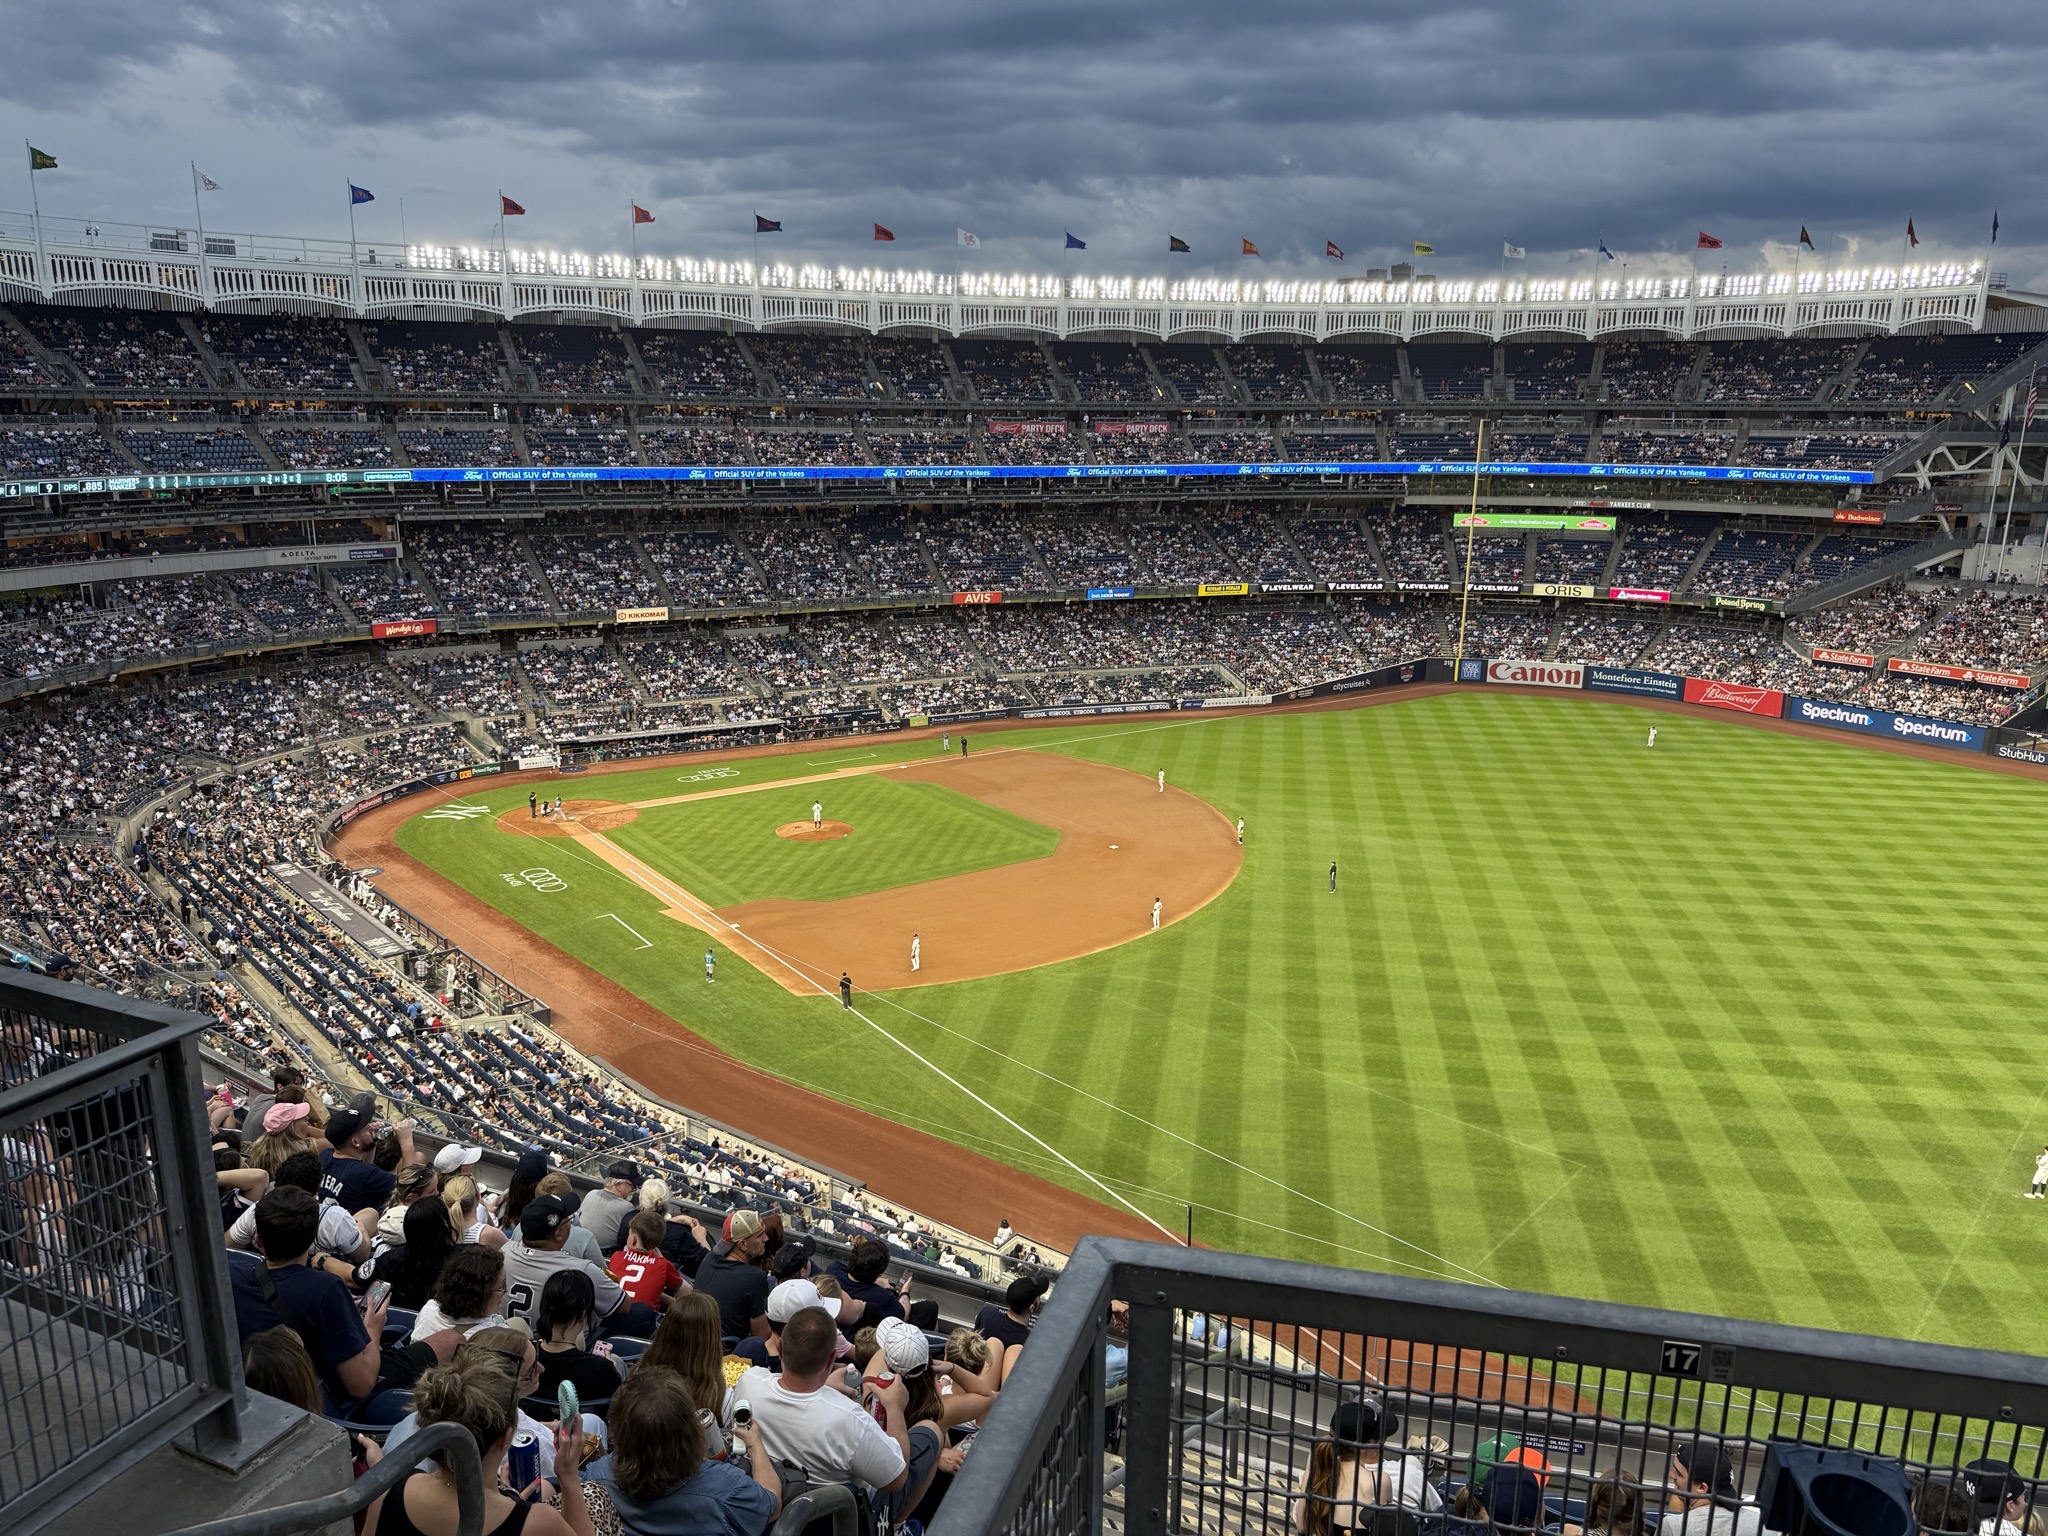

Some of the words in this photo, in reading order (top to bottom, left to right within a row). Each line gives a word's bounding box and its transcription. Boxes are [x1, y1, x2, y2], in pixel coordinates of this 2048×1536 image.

[1022, 424, 1044, 433] PARTY
[1046, 424, 1064, 433] DECK
[1126, 424, 1148, 433] PARTY
[1150, 425, 1168, 433] DECK
[326, 473, 348, 483] 8:05
[46, 484, 52, 493] 9
[83, 482, 102, 491] .885
[1848, 514, 1881, 522] Budweiser
[1545, 586, 1582, 596] ORIS
[965, 594, 991, 603] AVIS
[1715, 597, 1740, 607] Poland
[1740, 599, 1765, 611] Spring
[386, 624, 412, 636] Wendy's
[1489, 662, 1580, 685] Canon
[1593, 671, 1641, 684] Montefiore
[1643, 676, 1677, 689] Einstein
[1333, 681, 1365, 691] citycruises
[1706, 687, 1758, 704] Budweiser
[1802, 703, 1868, 725] Spectrum
[1894, 718, 1966, 742] Spectrum
[1999, 747, 2045, 763] StubHub
[358, 796, 382, 810] Budweiser
[499, 873, 526, 887] Audi
[624, 1251, 655, 1264] HAKIMI
[620, 1264, 645, 1298] 2
[507, 1283, 535, 1326] 2
[1665, 1348, 1698, 1372] 17
